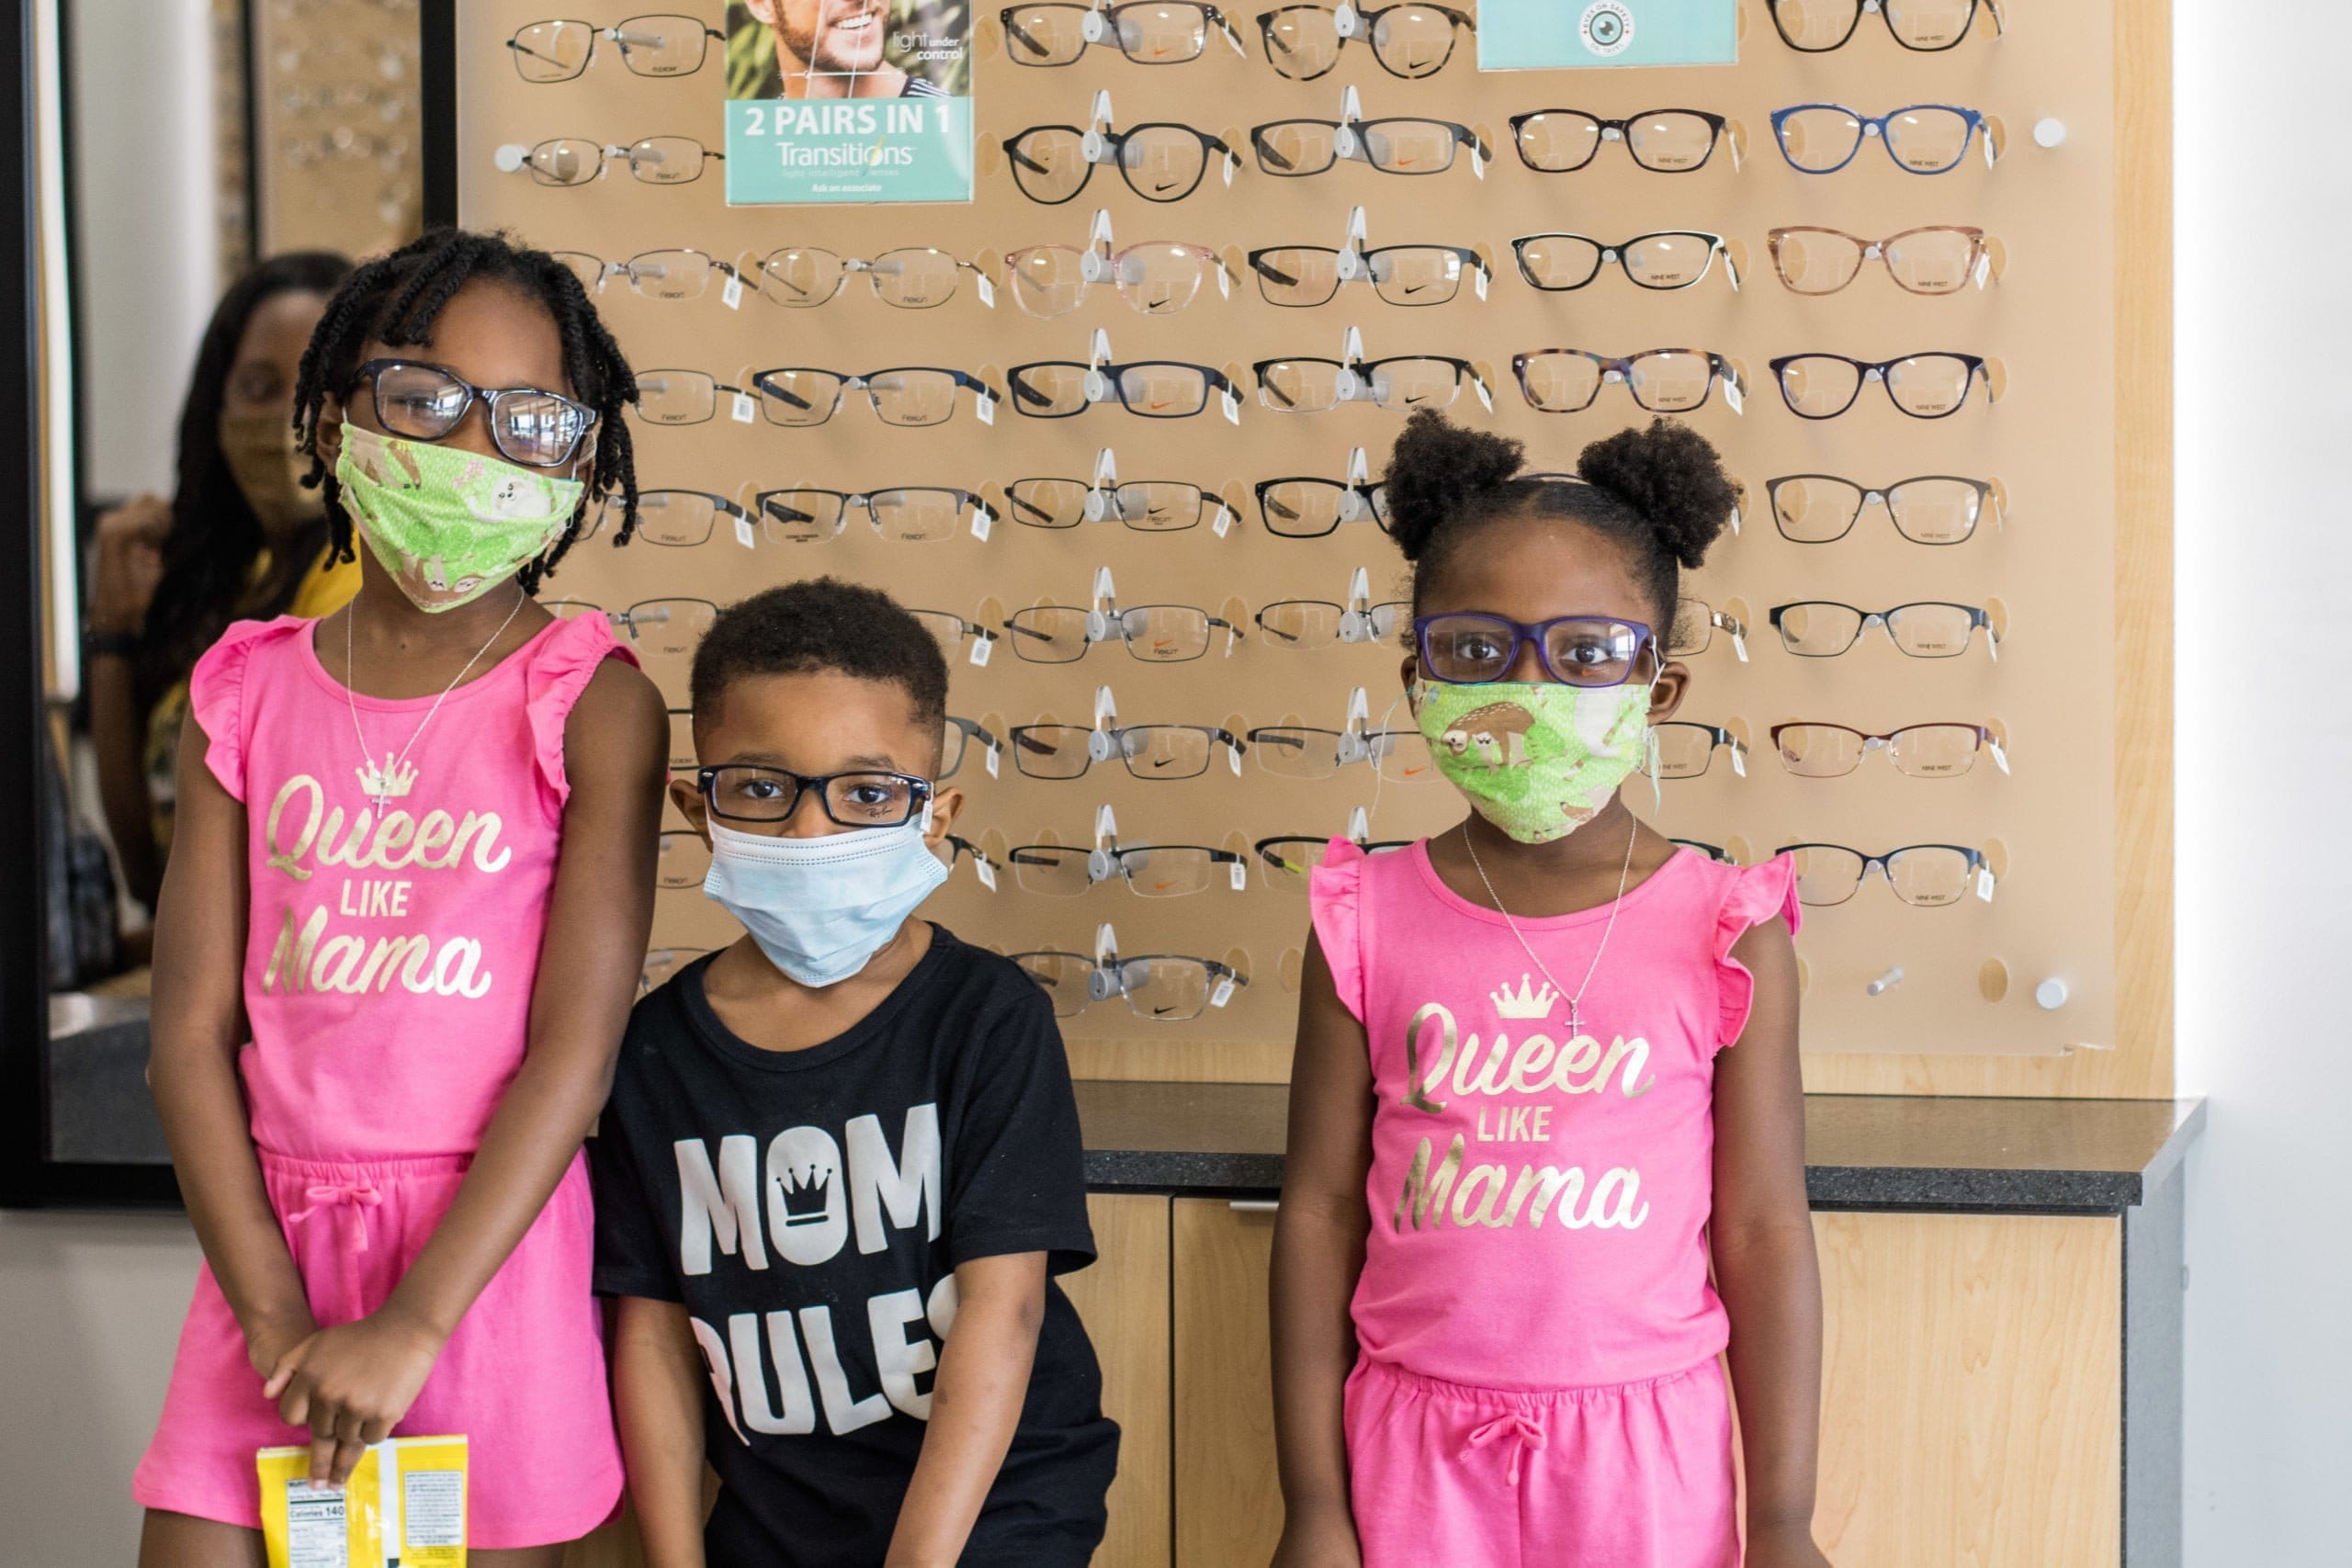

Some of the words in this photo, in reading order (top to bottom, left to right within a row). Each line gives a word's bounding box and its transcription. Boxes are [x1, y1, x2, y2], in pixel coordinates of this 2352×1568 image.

[893, 30, 928, 53] light
[929, 37, 959, 48] under
[917, 47, 964, 60] control
[744, 107, 765, 136] 2
[775, 104, 877, 135] PAIRS
[887, 104, 923, 134] IN
[934, 104, 950, 133] 1
[775, 141, 913, 166] Transitions
[266, 774, 512, 881] Queen
[340, 879, 412, 918] LIKE
[263, 905, 492, 998] Mama
[1399, 1002, 1656, 1114] Queen
[1476, 1106, 1554, 1142] LIKE
[673, 1102, 942, 1276] MOM
[1394, 1133, 1649, 1235] Mama
[325, 1506, 345, 1517] 140
